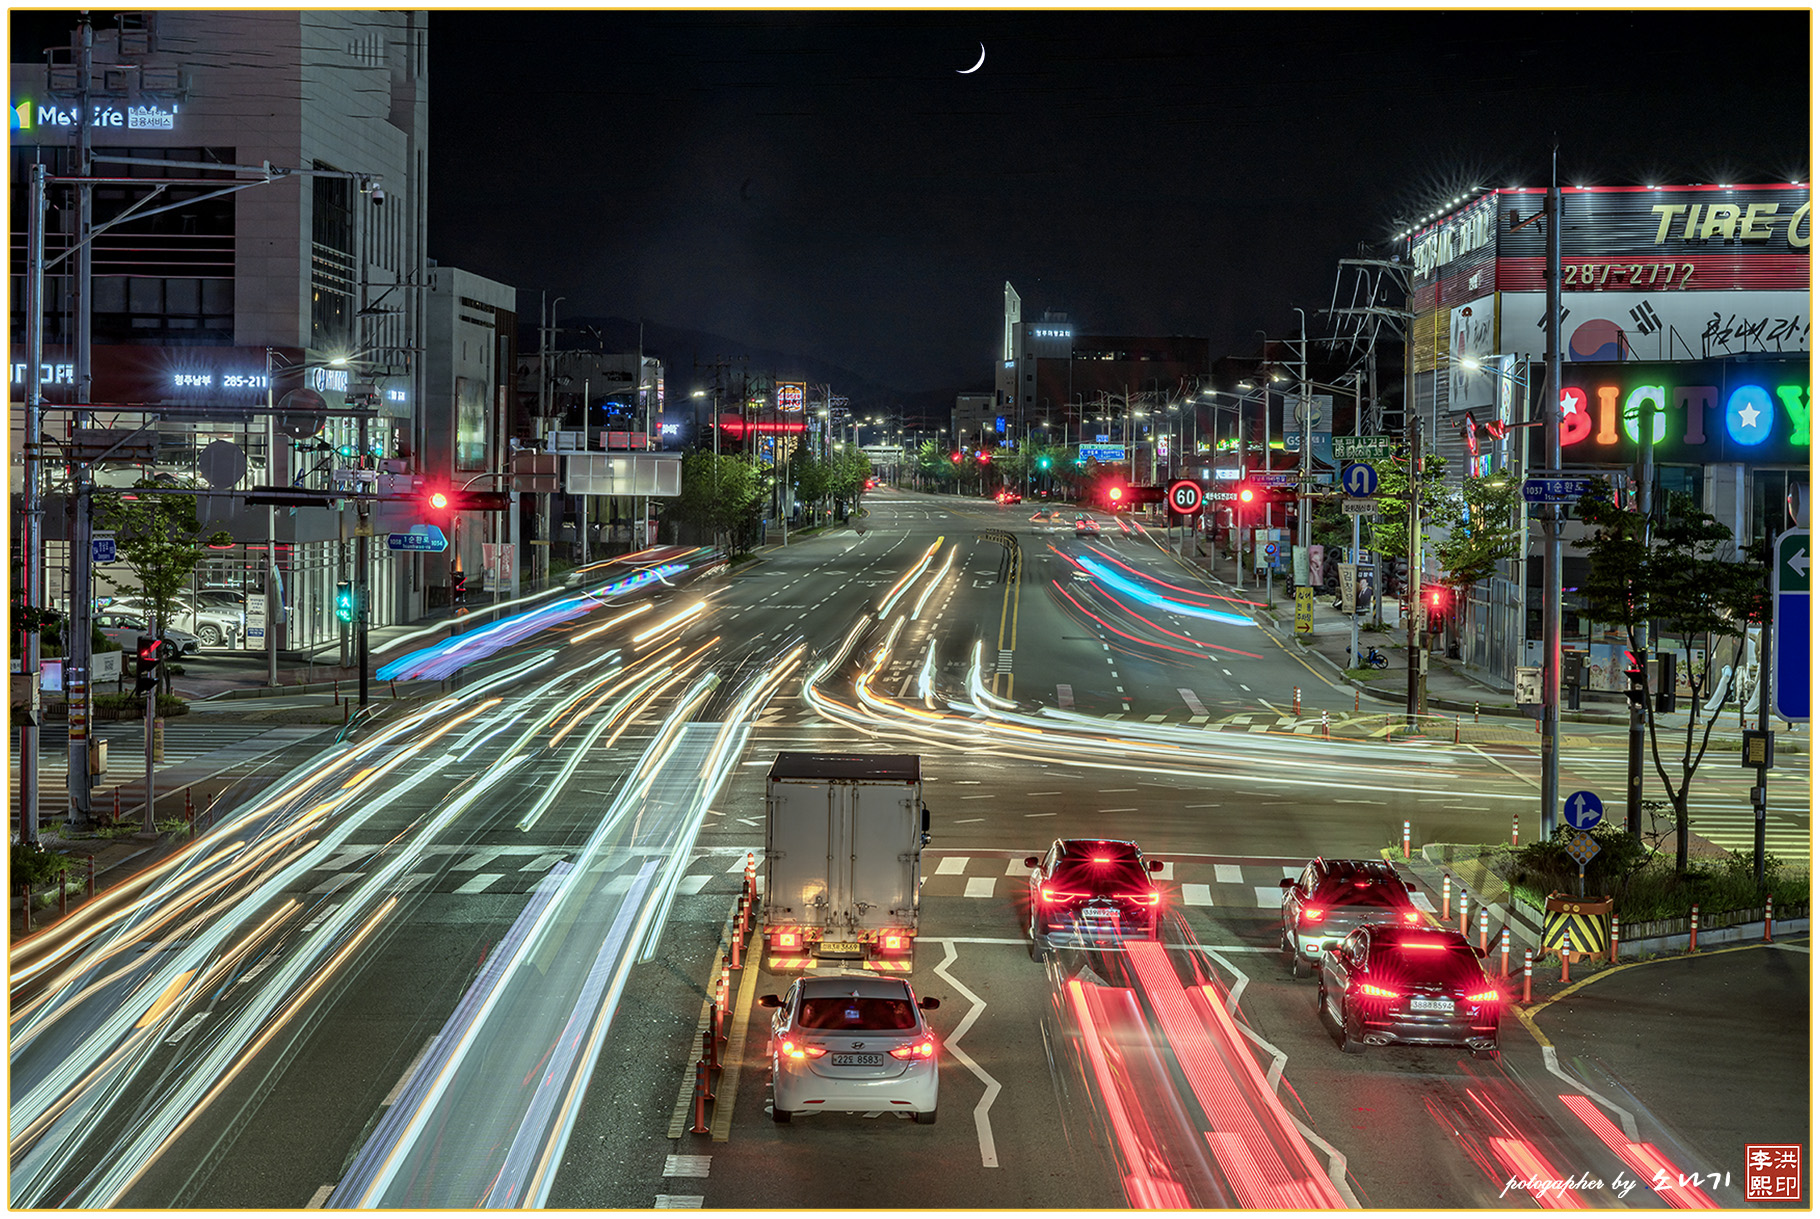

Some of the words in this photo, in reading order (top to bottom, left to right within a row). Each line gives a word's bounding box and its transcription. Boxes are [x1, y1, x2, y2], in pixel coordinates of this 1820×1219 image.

[130, 117, 171, 126] 금융서비스
[1651, 203, 1779, 244] TIRE
[1565, 263, 1694, 287] 287-2772
[174, 374, 212, 386] 청주남부
[1560, 384, 1810, 446] BIGTOY
[1176, 489, 1195, 505] 60
[1526, 487, 1543, 495] 1037
[857, 1055, 879, 1064] 8583
